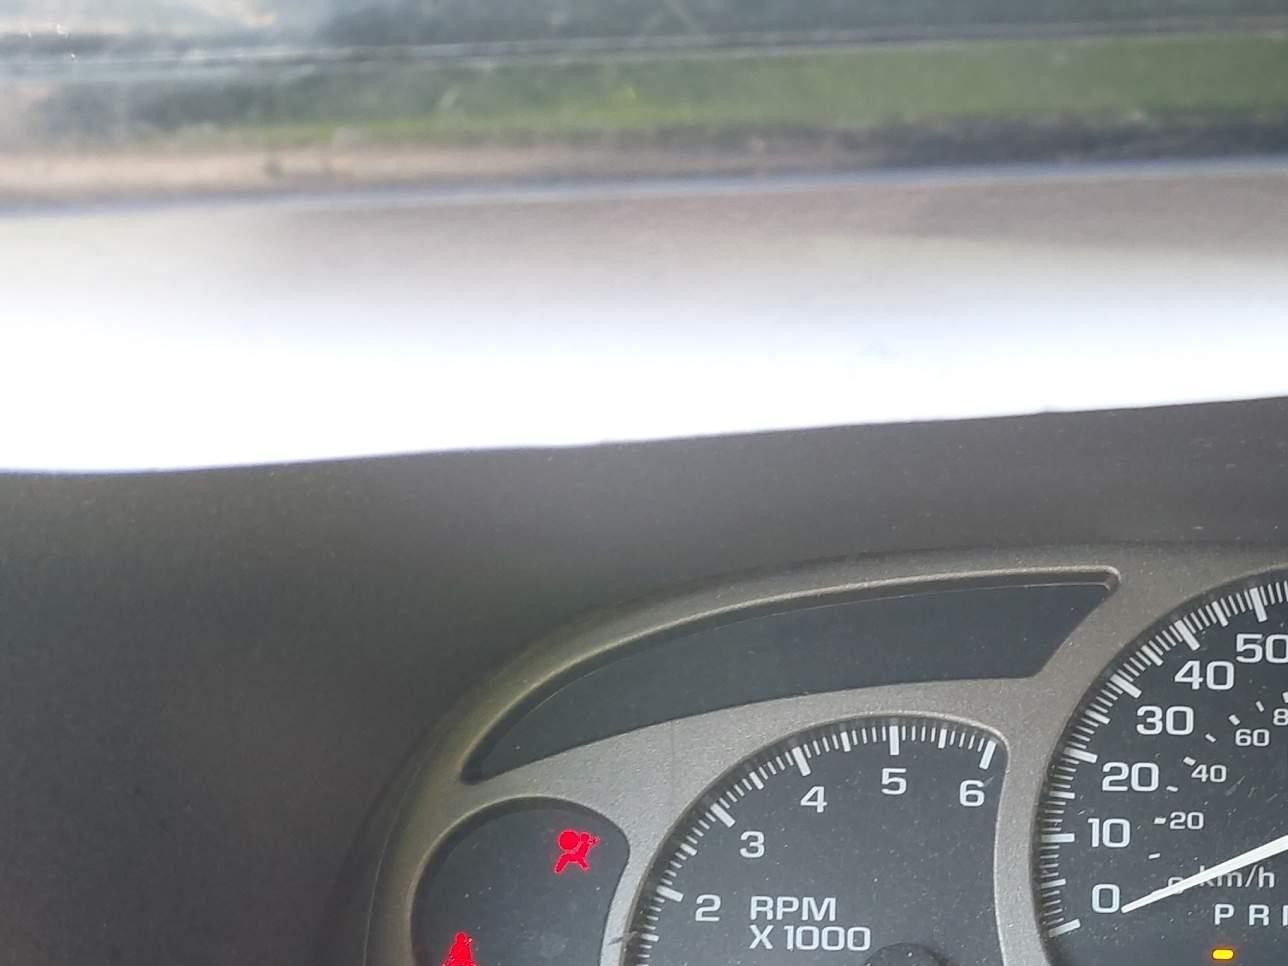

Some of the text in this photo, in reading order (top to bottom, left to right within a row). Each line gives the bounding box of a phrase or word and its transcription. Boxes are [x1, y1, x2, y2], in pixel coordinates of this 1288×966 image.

[1174, 660, 1234, 690] 40
[1136, 705, 1194, 736] 30
[1235, 728, 1270, 747] 60
[881, 767, 907, 795] 5
[1102, 761, 1159, 792] 20
[1191, 764, 1227, 783] 40
[800, 786, 828, 813] 4
[959, 779, 985, 807] 6
[1087, 818, 1131, 848] 10
[1169, 811, 1204, 830] 20
[739, 831, 765, 858] 3
[695, 894, 721, 922] 2
[750, 895, 836, 922] RPM
[1091, 883, 1121, 914] 0
[1214, 903, 1235, 925] P
[1248, 904, 1270, 926] R
[749, 924, 871, 951] X 1000
